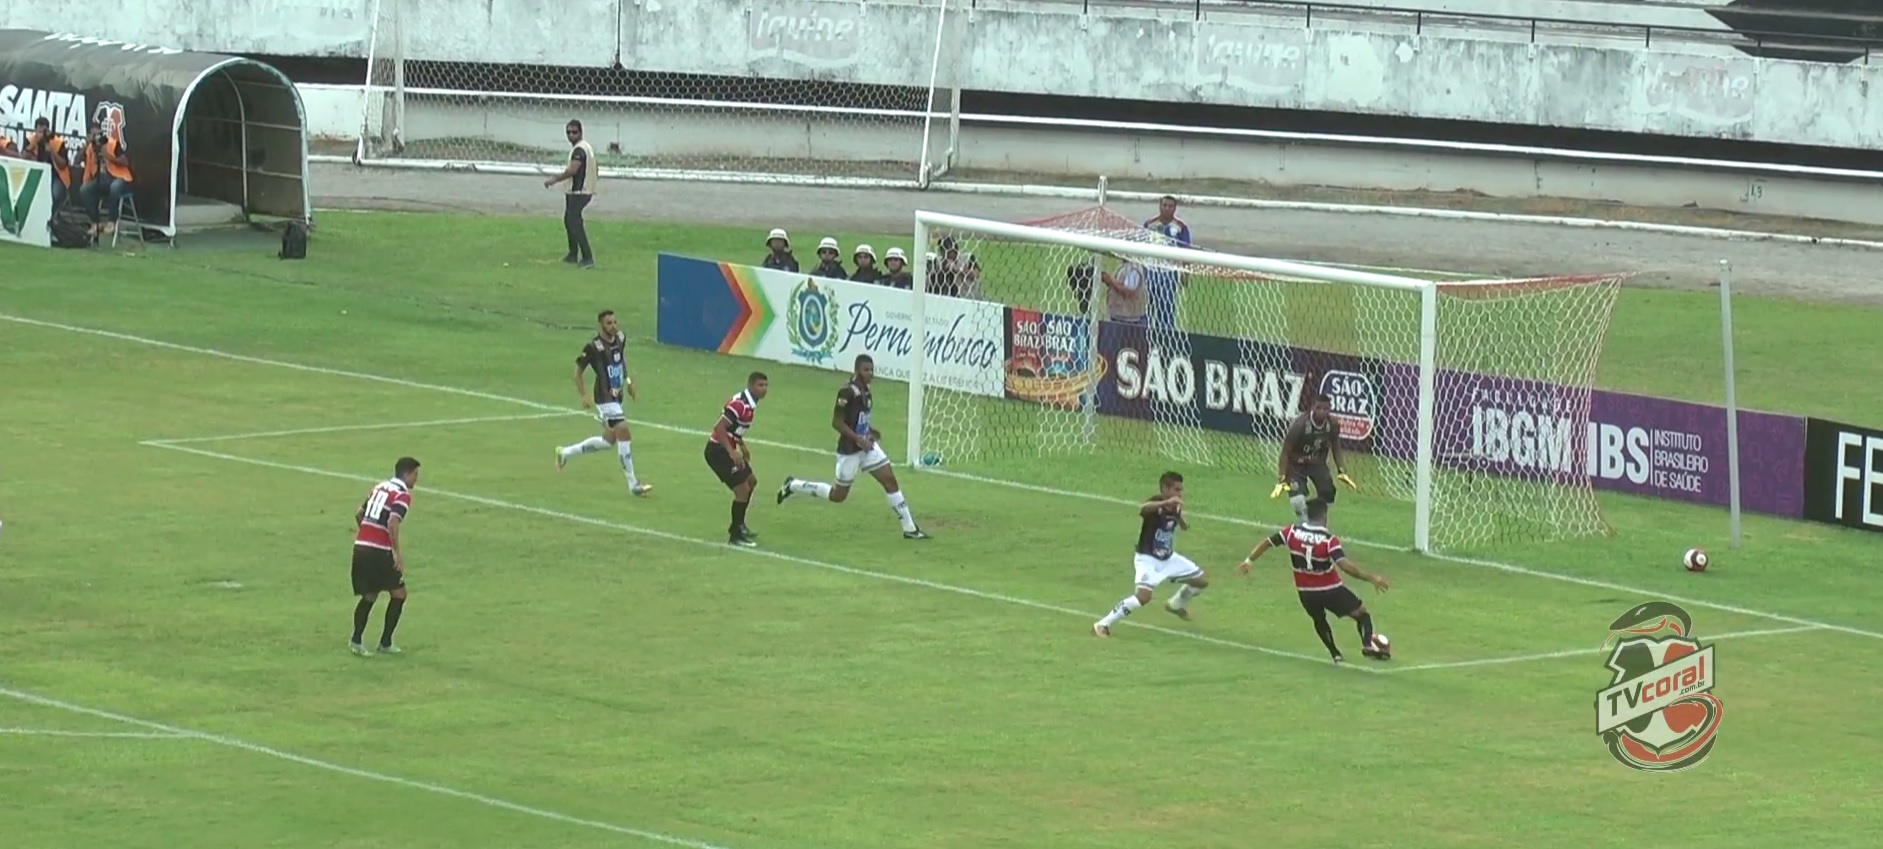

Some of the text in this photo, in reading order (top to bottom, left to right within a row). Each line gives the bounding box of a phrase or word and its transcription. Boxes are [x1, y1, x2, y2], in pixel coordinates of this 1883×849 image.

[0, 84, 87, 138] SANTA
[1205, 359, 1304, 420] BRAZ
[1586, 421, 1650, 484] IBS
[1654, 429, 1702, 452] INSTITUTO
[1654, 449, 1709, 473] BRASILEIRO
[1654, 470, 1702, 493] DE SAÚDE
[1835, 431, 1883, 527] FE
[364, 488, 389, 520] 10
